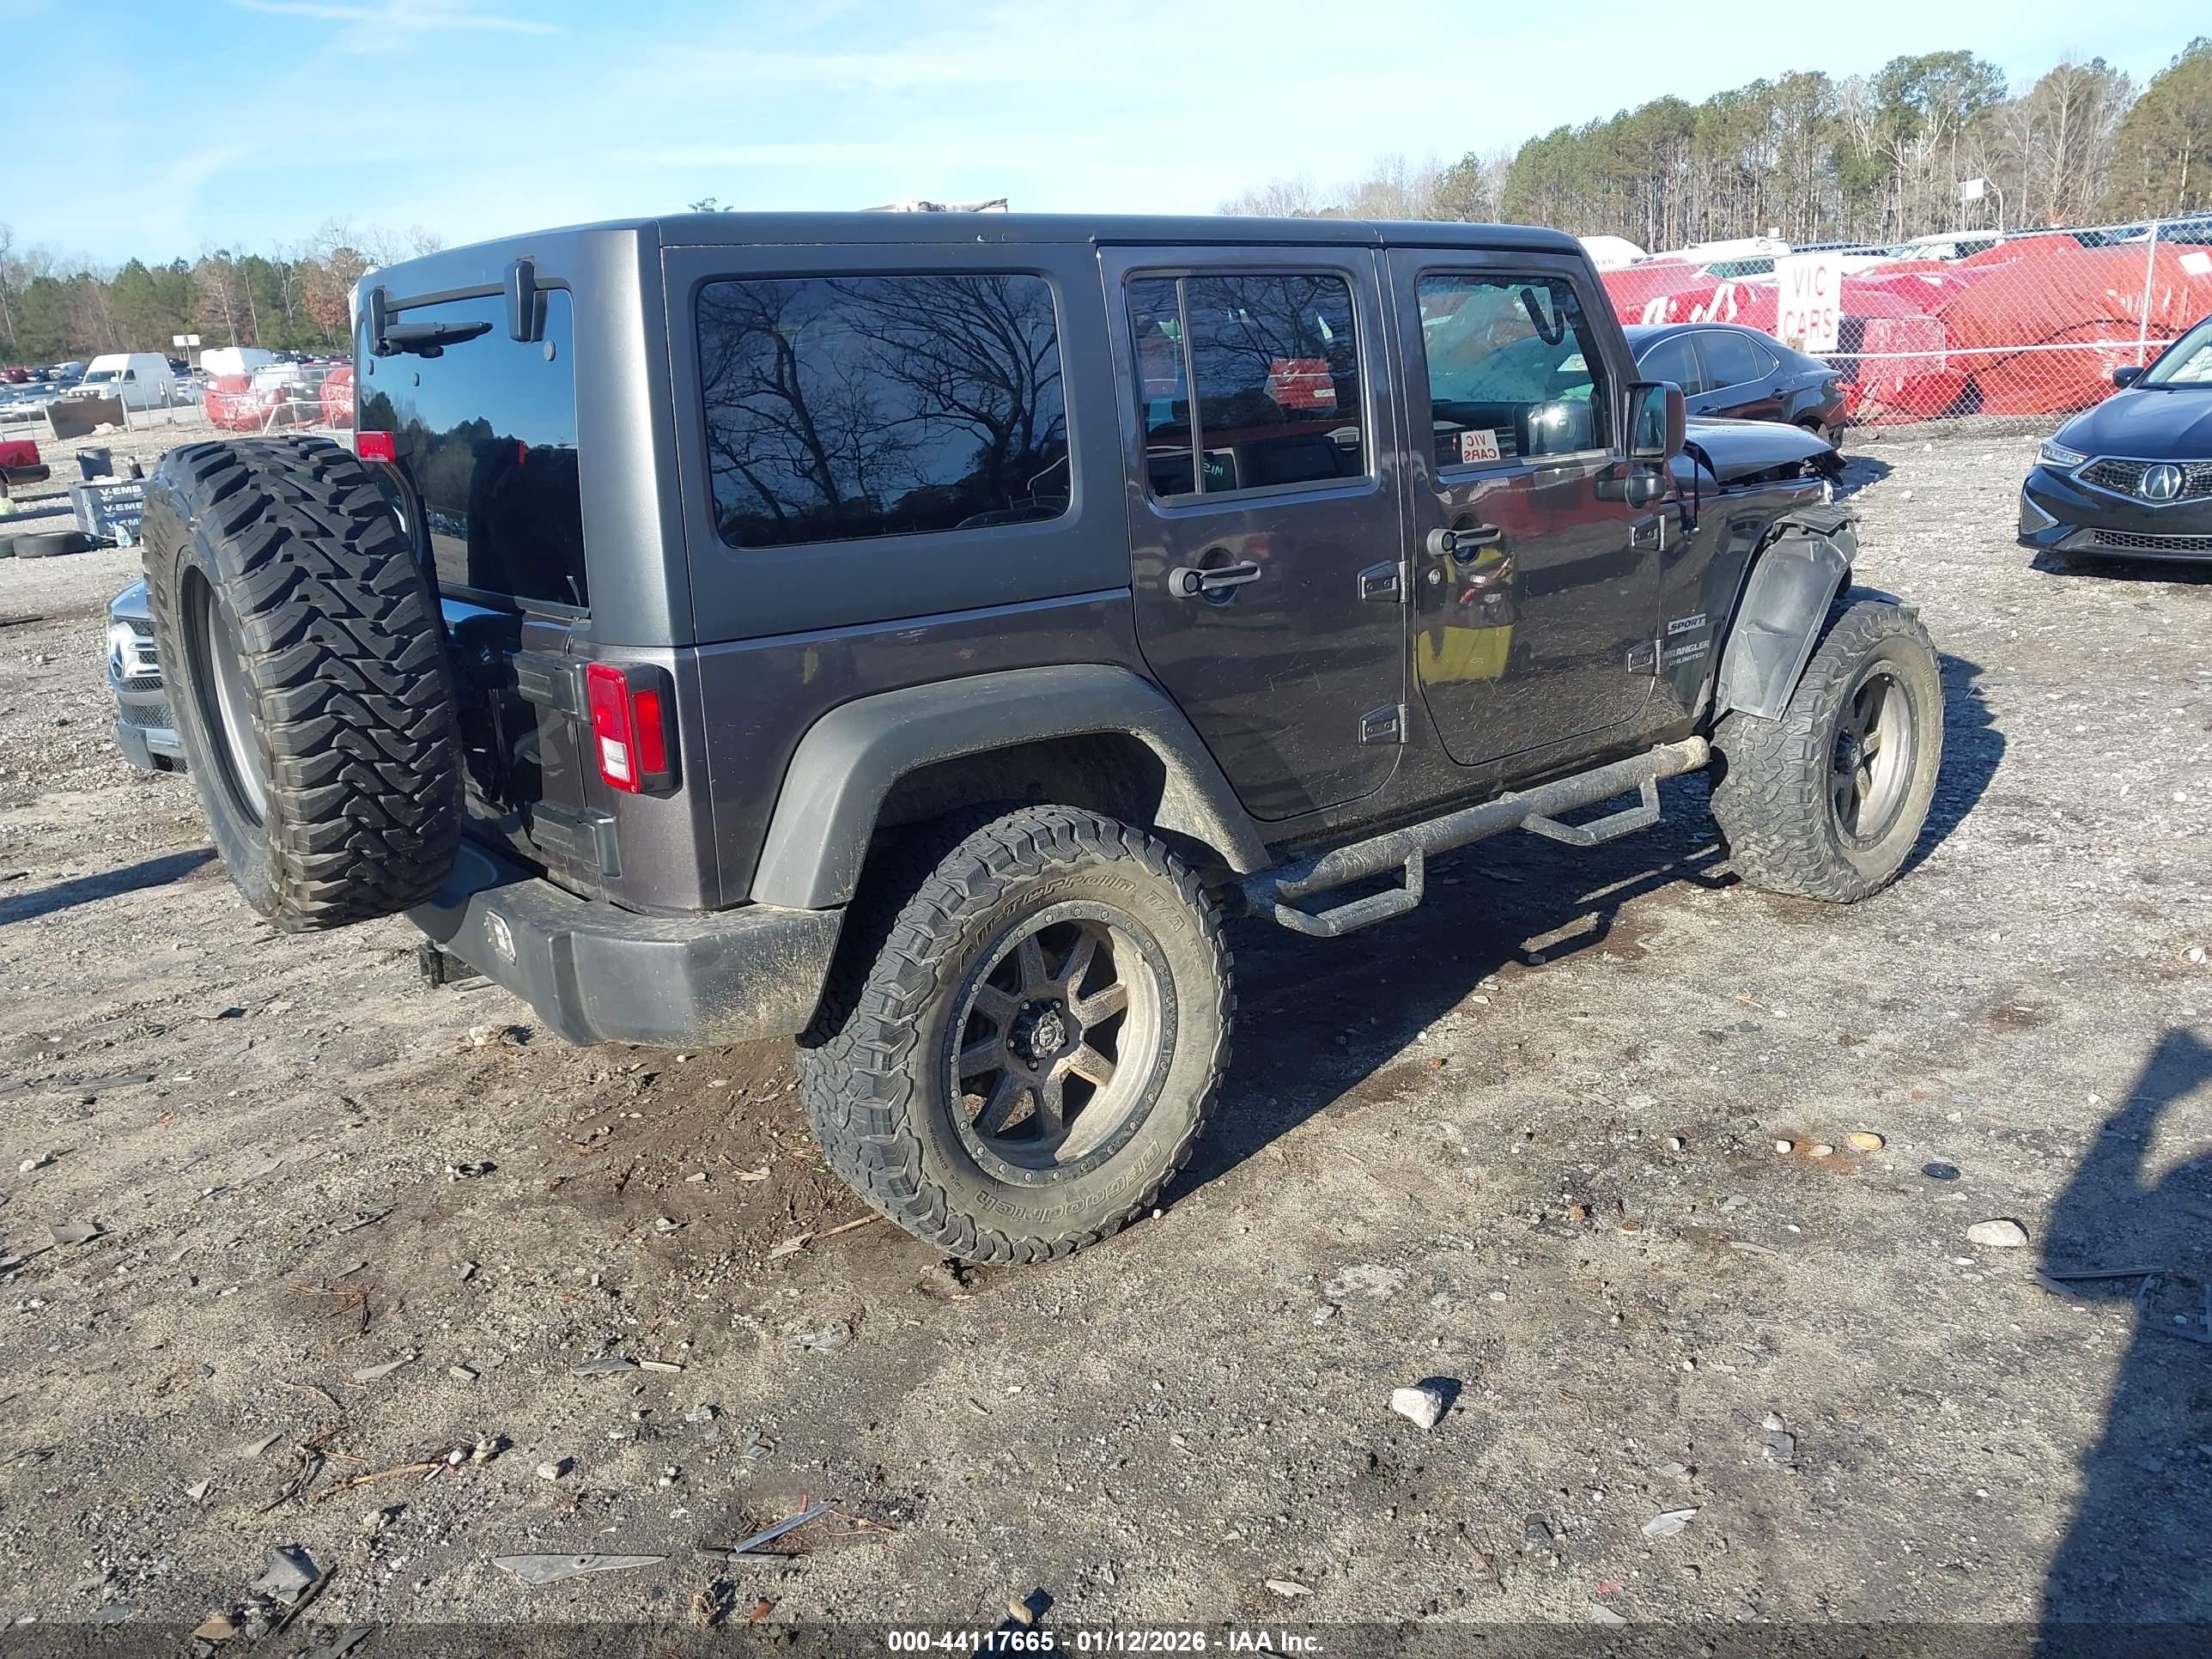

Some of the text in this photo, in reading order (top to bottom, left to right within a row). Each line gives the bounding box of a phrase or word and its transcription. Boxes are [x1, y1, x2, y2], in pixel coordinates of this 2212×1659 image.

[1793, 265, 1827, 298] VIC
[1784, 307, 1832, 339] CARS
[1670, 618, 1704, 631] SPORT
[1663, 640, 1711, 659] WRANGLER
[1668, 652, 1705, 666] UNLIMITED
[1143, 889, 1186, 933] T/A
[973, 1139, 1162, 1224] BFGoodrich
